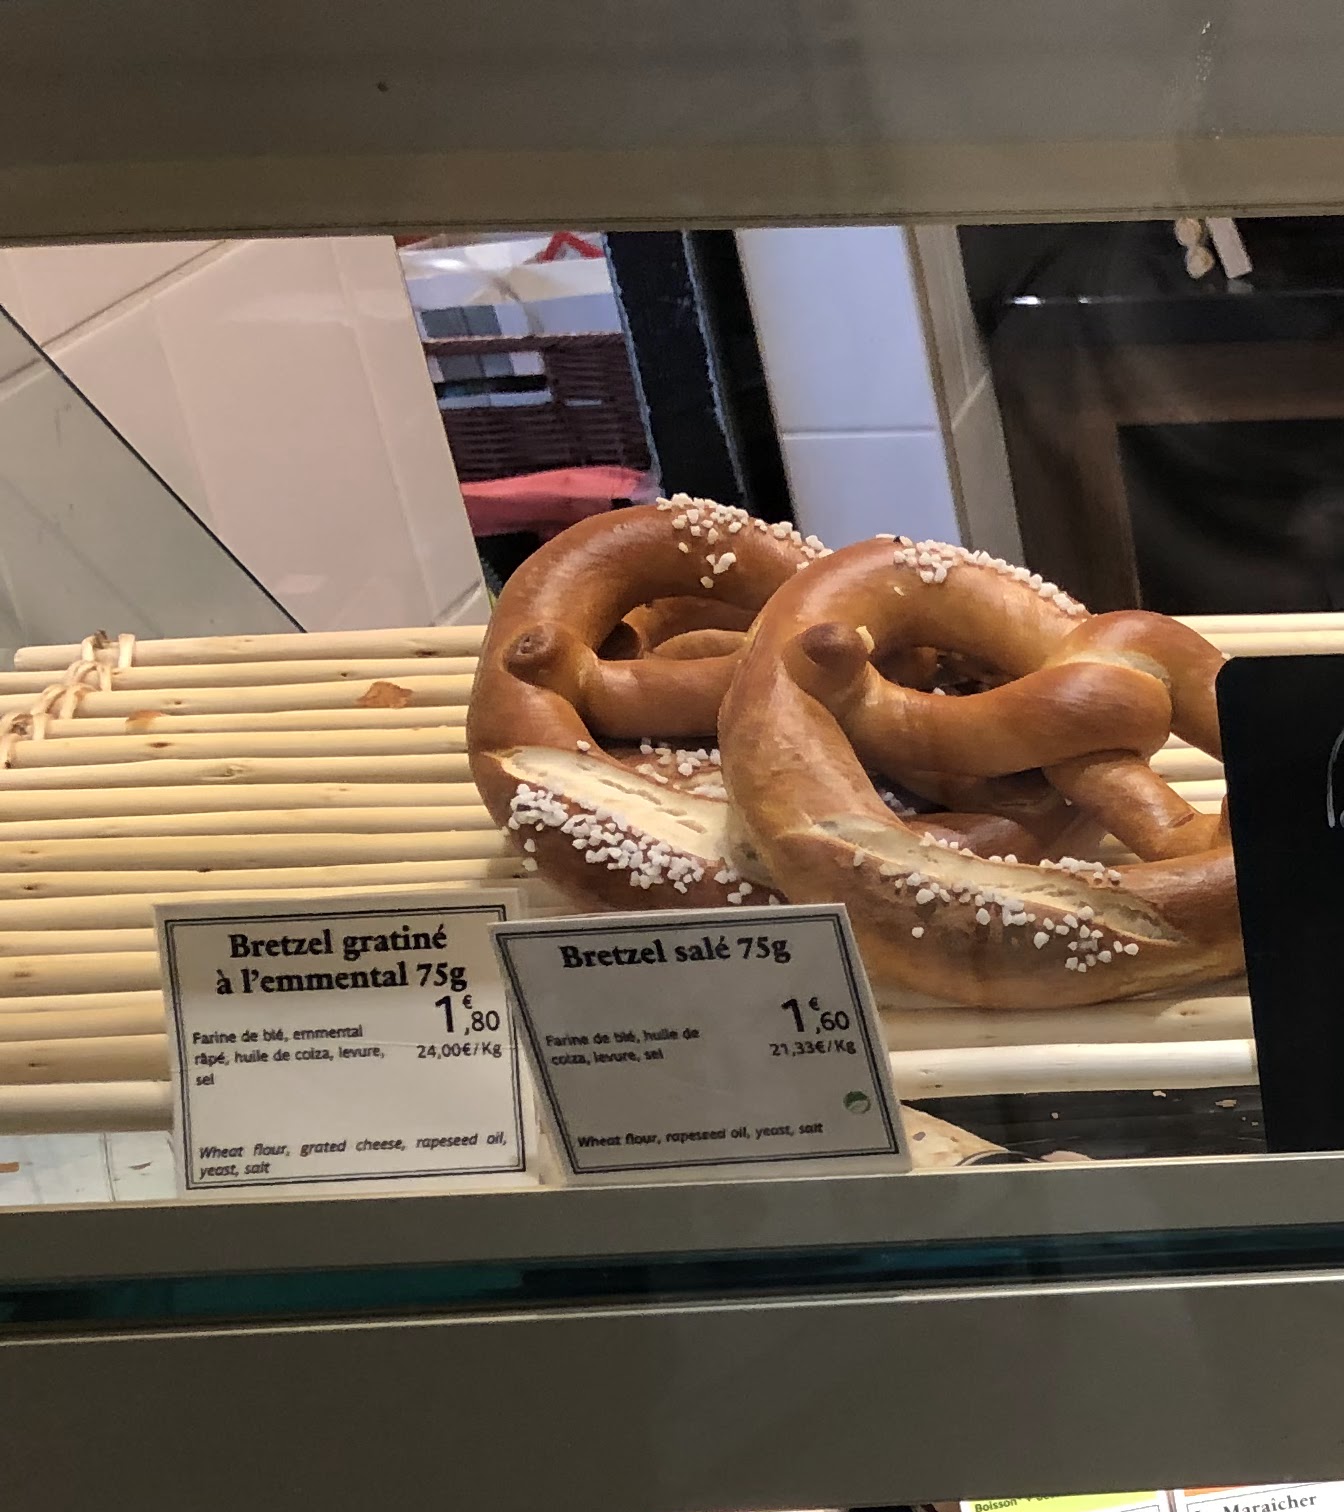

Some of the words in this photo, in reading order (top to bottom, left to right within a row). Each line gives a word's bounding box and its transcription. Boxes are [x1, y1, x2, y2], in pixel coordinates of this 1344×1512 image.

[229, 929, 333, 958] Bretzel
[343, 924, 448, 961] gratiné
[558, 939, 667, 968] Bretzel
[675, 937, 730, 963] salé
[737, 937, 791, 964] 75g
[216, 970, 233, 994] à
[416, 963, 467, 992] 75g
[192, 1031, 236, 1045] Farine
[241, 1030, 258, 1043] de
[262, 1028, 288, 1042] blé,
[293, 1025, 363, 1040] emmental
[196, 1074, 215, 1085] sel
